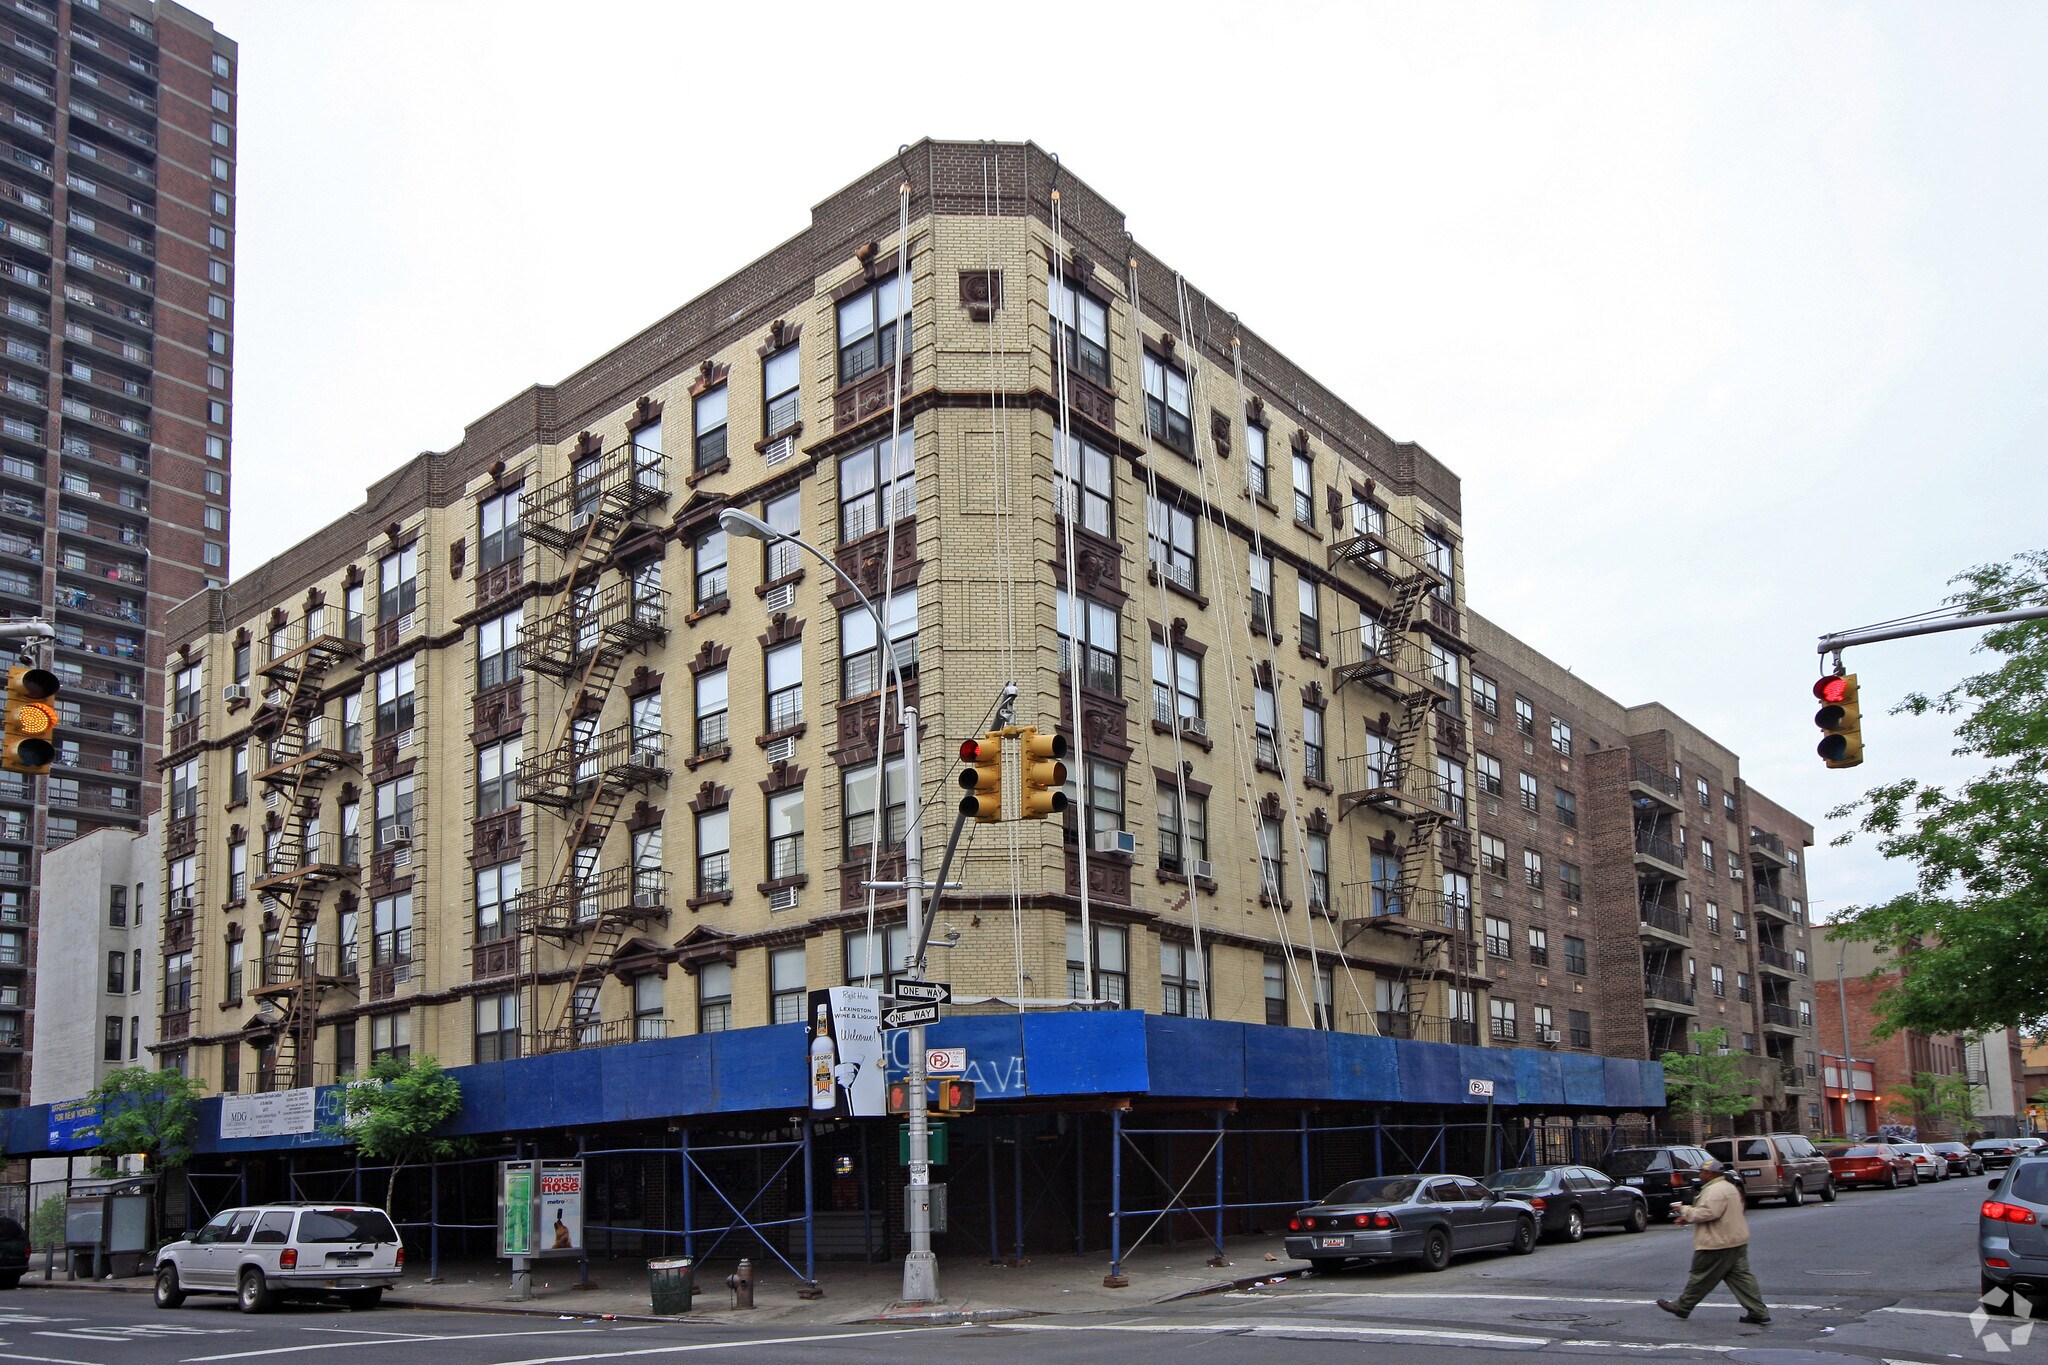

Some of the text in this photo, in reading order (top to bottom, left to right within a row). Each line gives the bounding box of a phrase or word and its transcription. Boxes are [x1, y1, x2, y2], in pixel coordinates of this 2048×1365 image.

[842, 990, 856, 1002] Right
[903, 986, 943, 998] ONE WAY
[889, 1009, 931, 1023] ONE WAY
[840, 1029, 876, 1042] Welcome!
[230, 1111, 247, 1122] MDG
[542, 1182, 582, 1193] nose.
